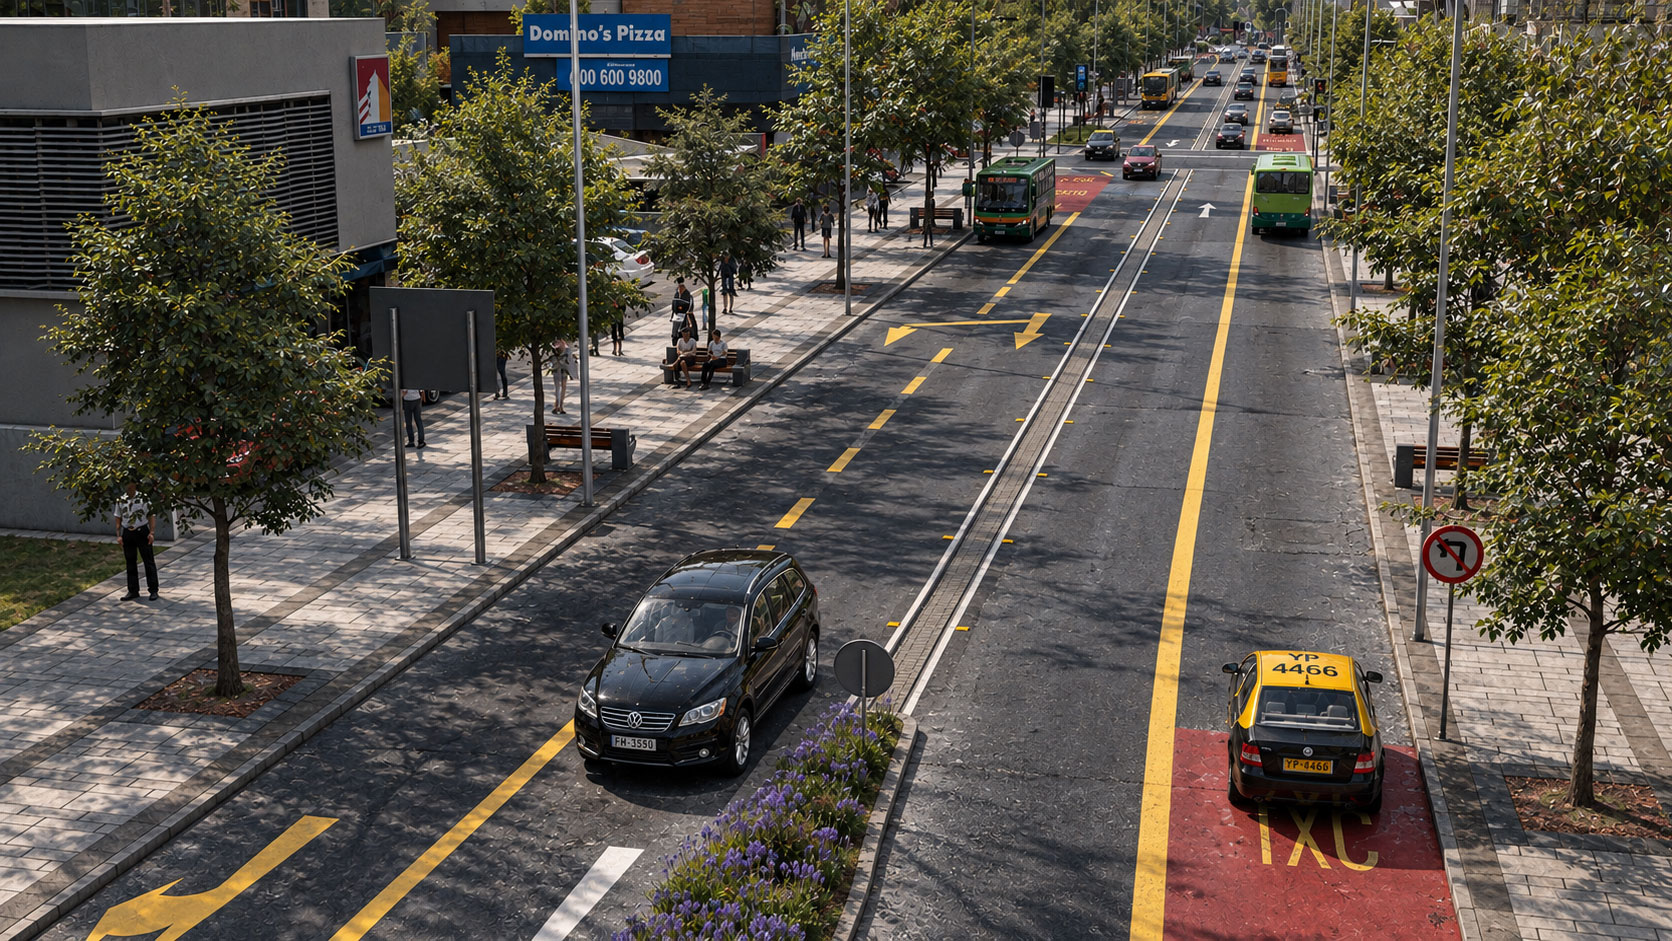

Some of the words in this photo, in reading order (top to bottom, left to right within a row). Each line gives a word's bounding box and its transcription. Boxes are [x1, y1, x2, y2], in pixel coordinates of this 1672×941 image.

[529, 24, 612, 42] Domno's
[616, 24, 665, 42] Pizza
[599, 68, 625, 86] 600
[628, 68, 662, 86] 9800
[1288, 653, 1320, 662] YP
[1272, 663, 1338, 677] 4466
